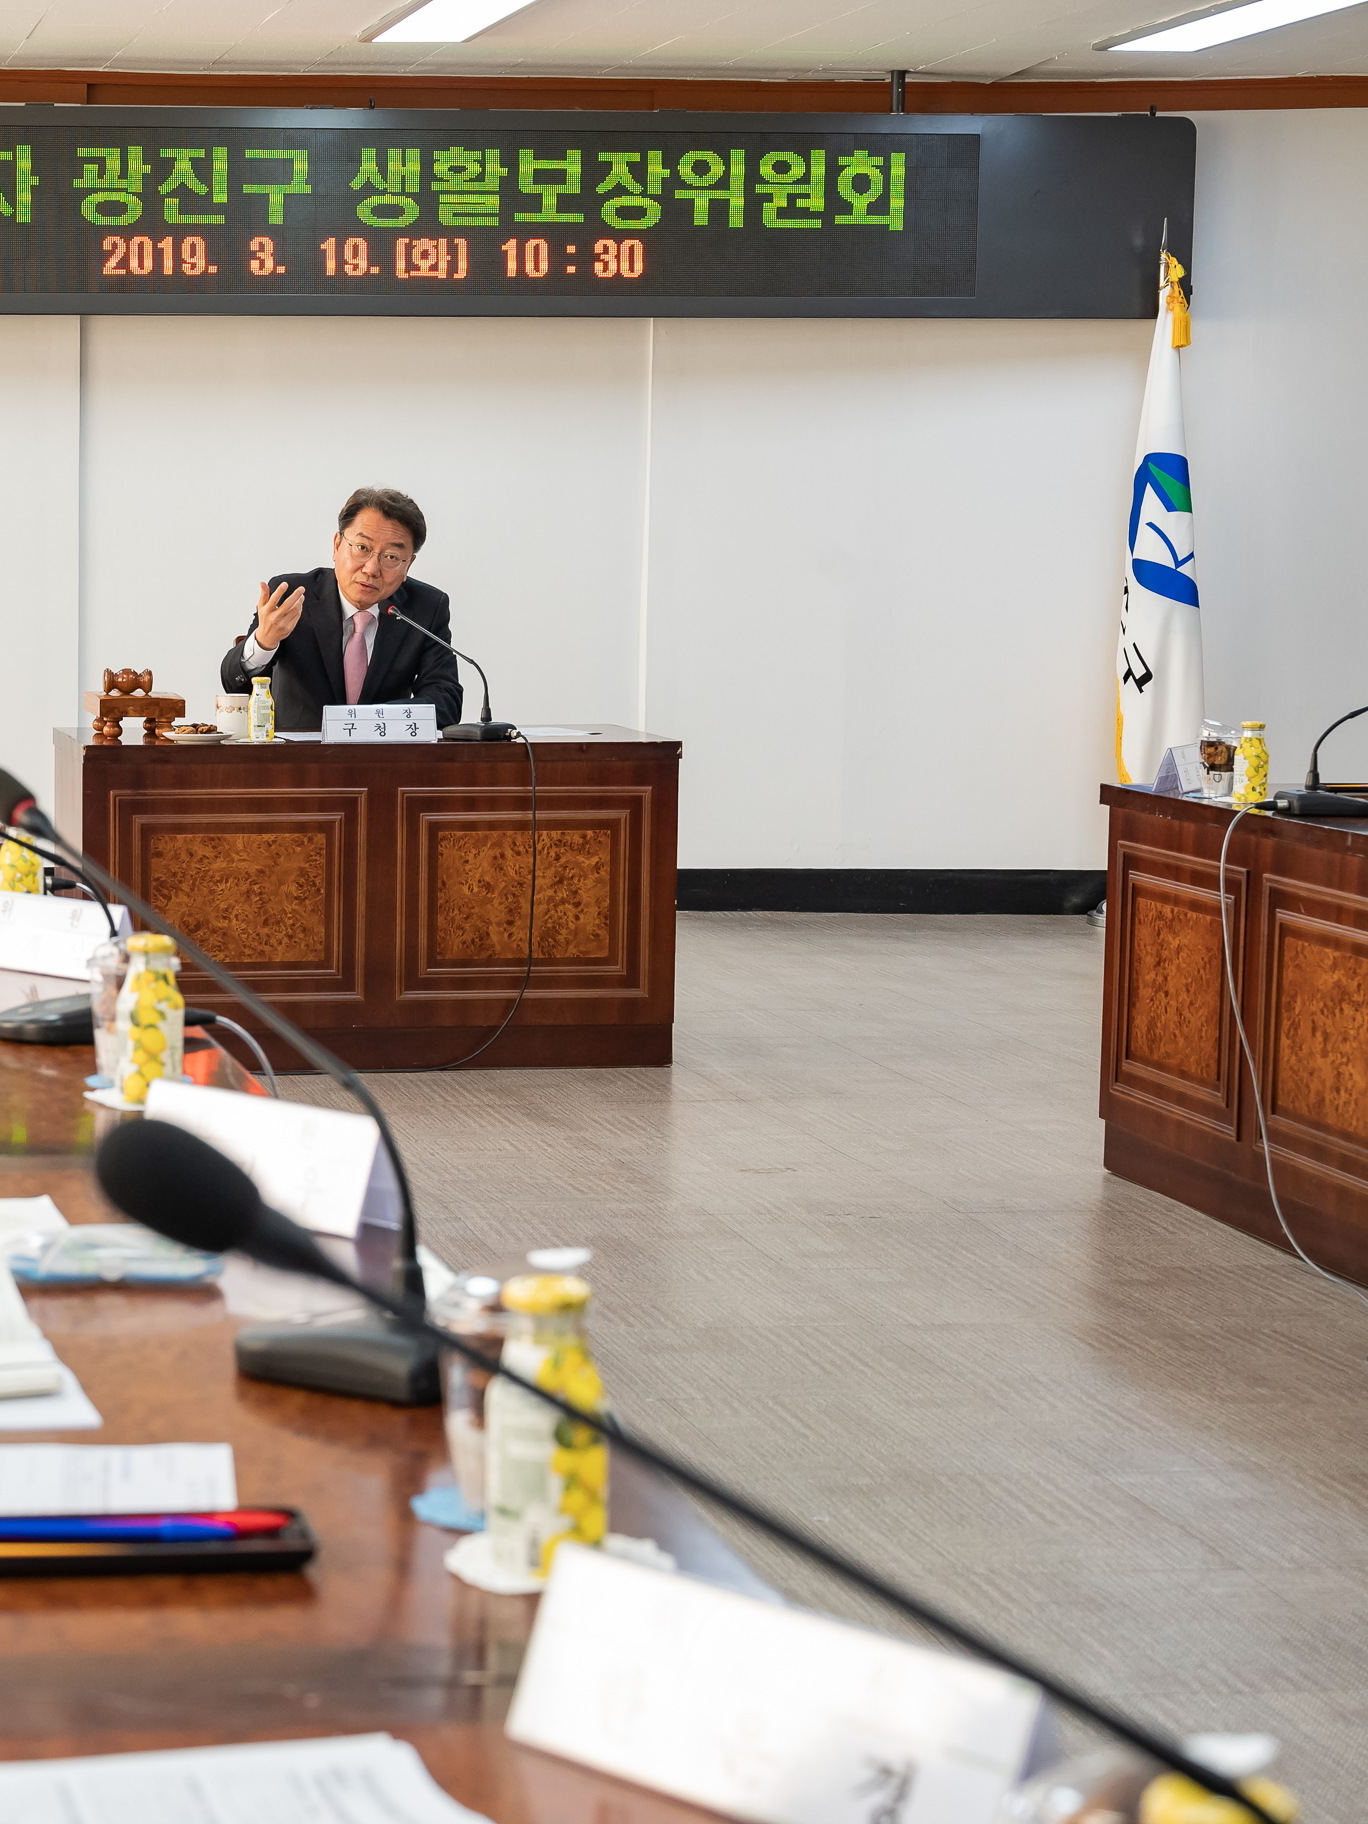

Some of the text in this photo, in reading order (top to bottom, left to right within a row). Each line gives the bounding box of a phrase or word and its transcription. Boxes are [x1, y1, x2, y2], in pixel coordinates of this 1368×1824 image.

[72, 146, 312, 225] 광진구
[349, 146, 906, 231] 생활보장위원회
[102, 235, 218, 275] 2019.
[249, 235, 286, 276] 3.
